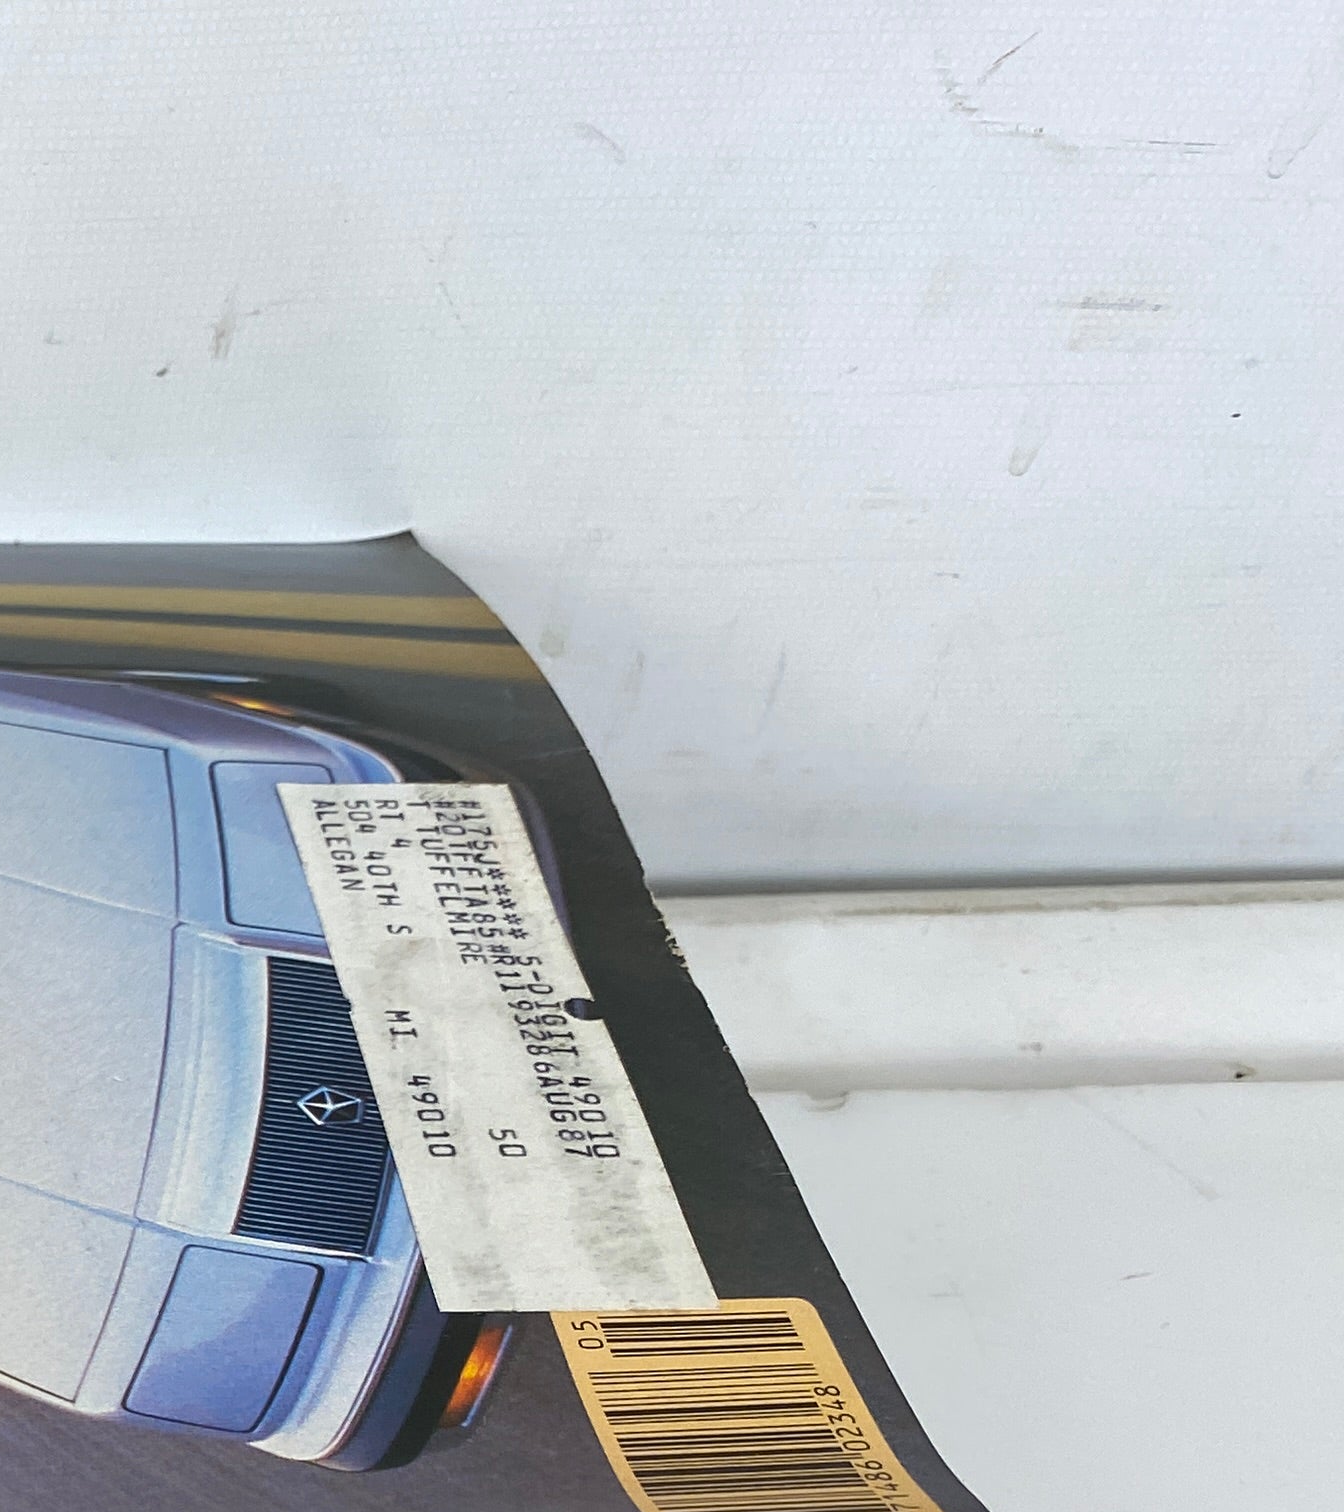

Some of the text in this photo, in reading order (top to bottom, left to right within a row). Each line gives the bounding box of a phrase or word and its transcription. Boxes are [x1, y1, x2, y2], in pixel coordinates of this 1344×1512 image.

[344, 800, 413, 934] 504 40TH S
[416, 826, 487, 965] TUFFELMIRE
[312, 800, 365, 891] ALLEGAN
[407, 1075, 457, 1158] 49010
[569, 1076, 621, 1159] 49010
[571, 1318, 605, 1351] 05
